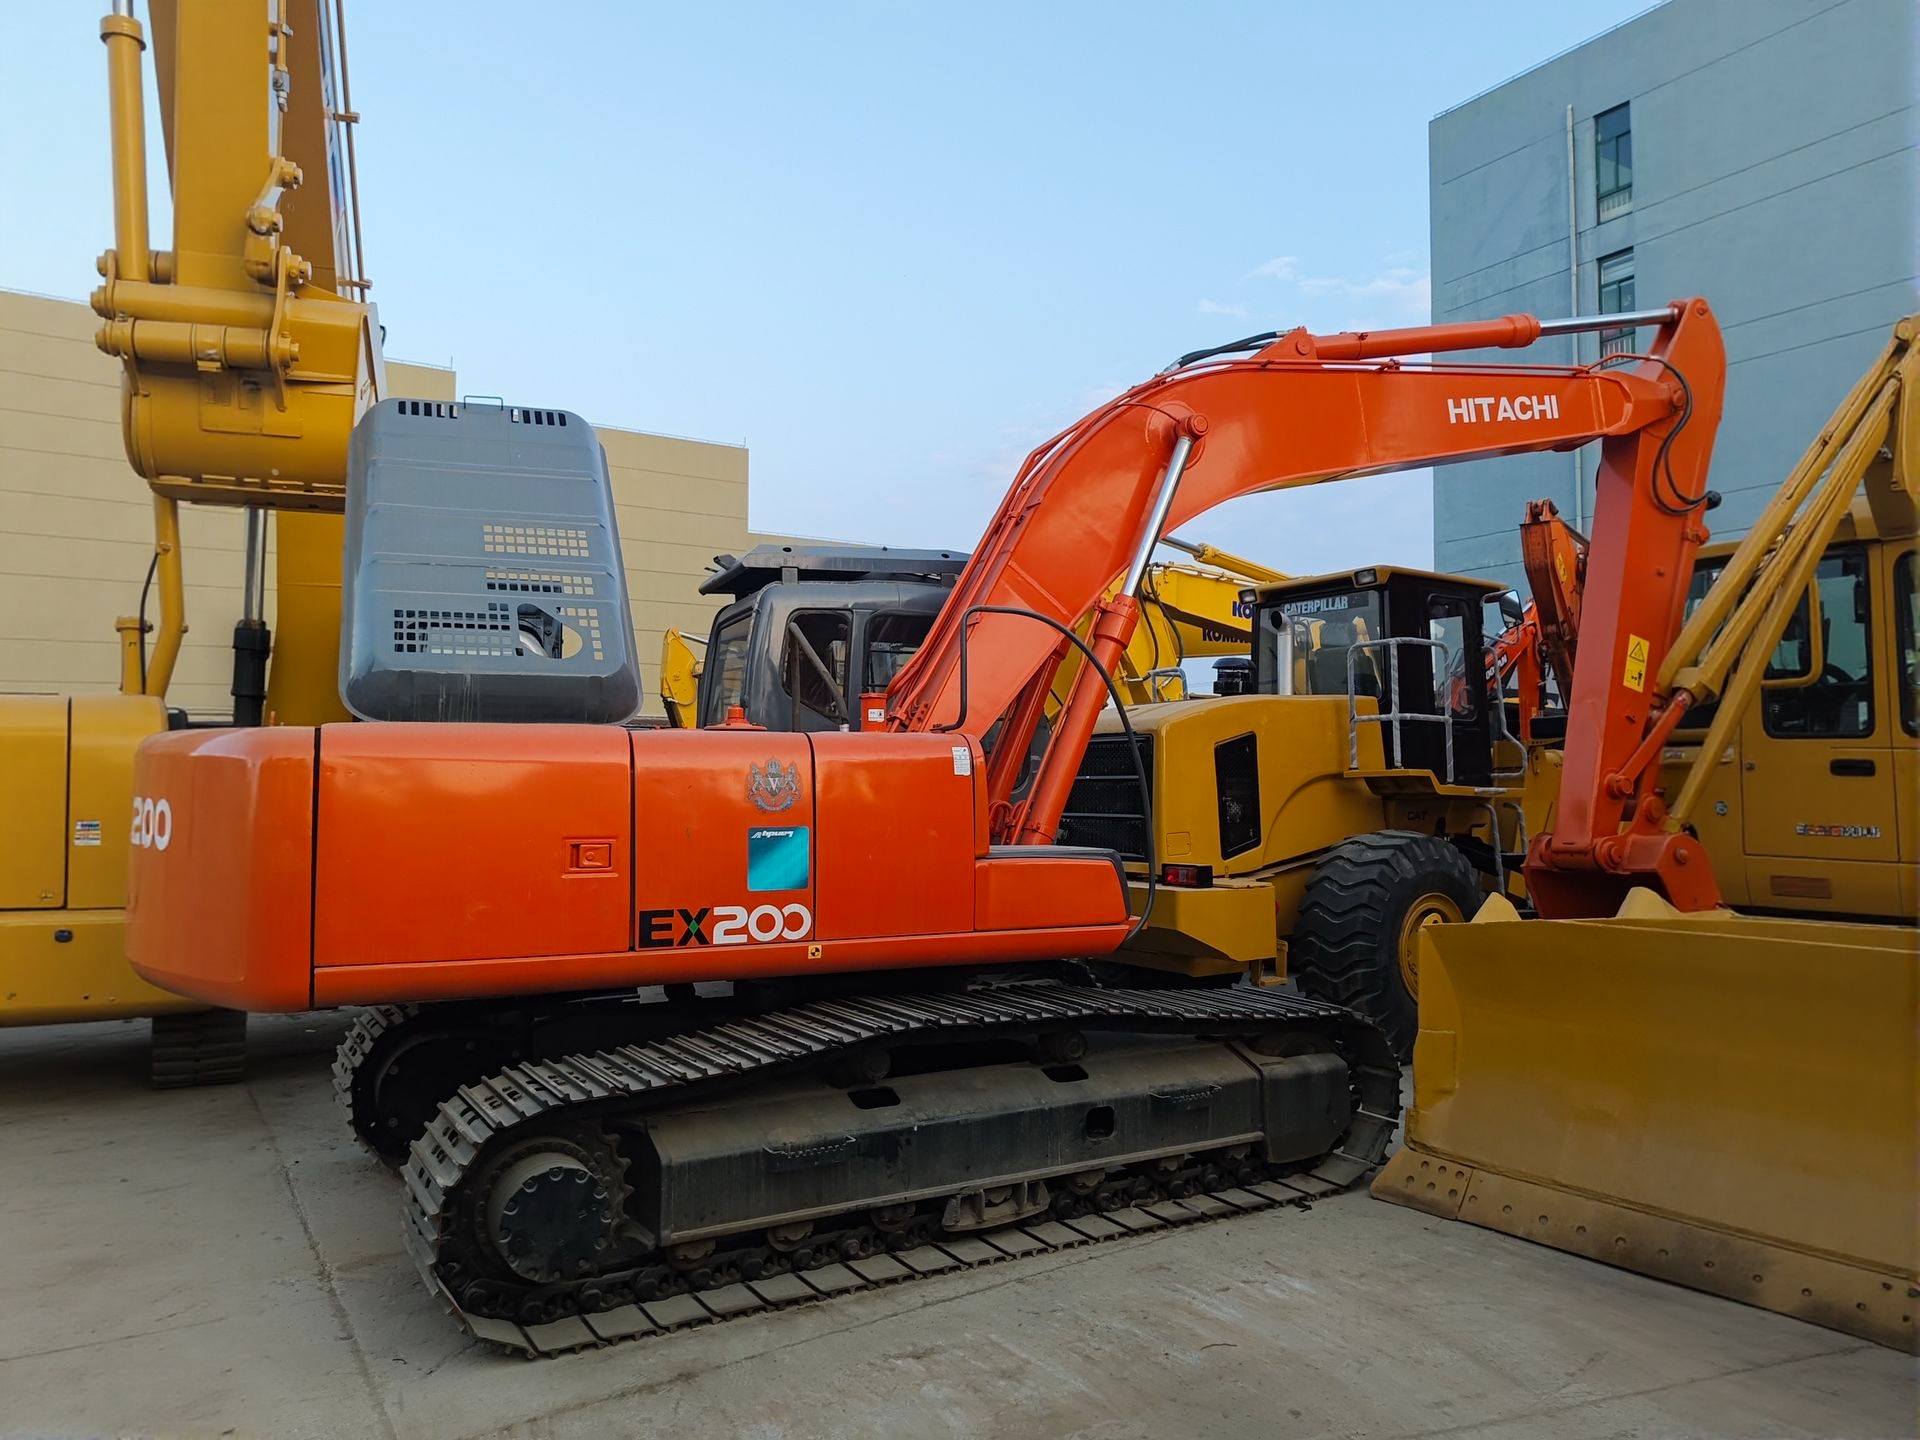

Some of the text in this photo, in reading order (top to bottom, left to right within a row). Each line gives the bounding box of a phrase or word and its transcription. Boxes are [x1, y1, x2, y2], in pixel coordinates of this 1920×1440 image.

[1447, 394, 1559, 424] HITACHI
[1283, 596, 1348, 616] CATERPILLAR
[638, 903, 812, 949] EX200
